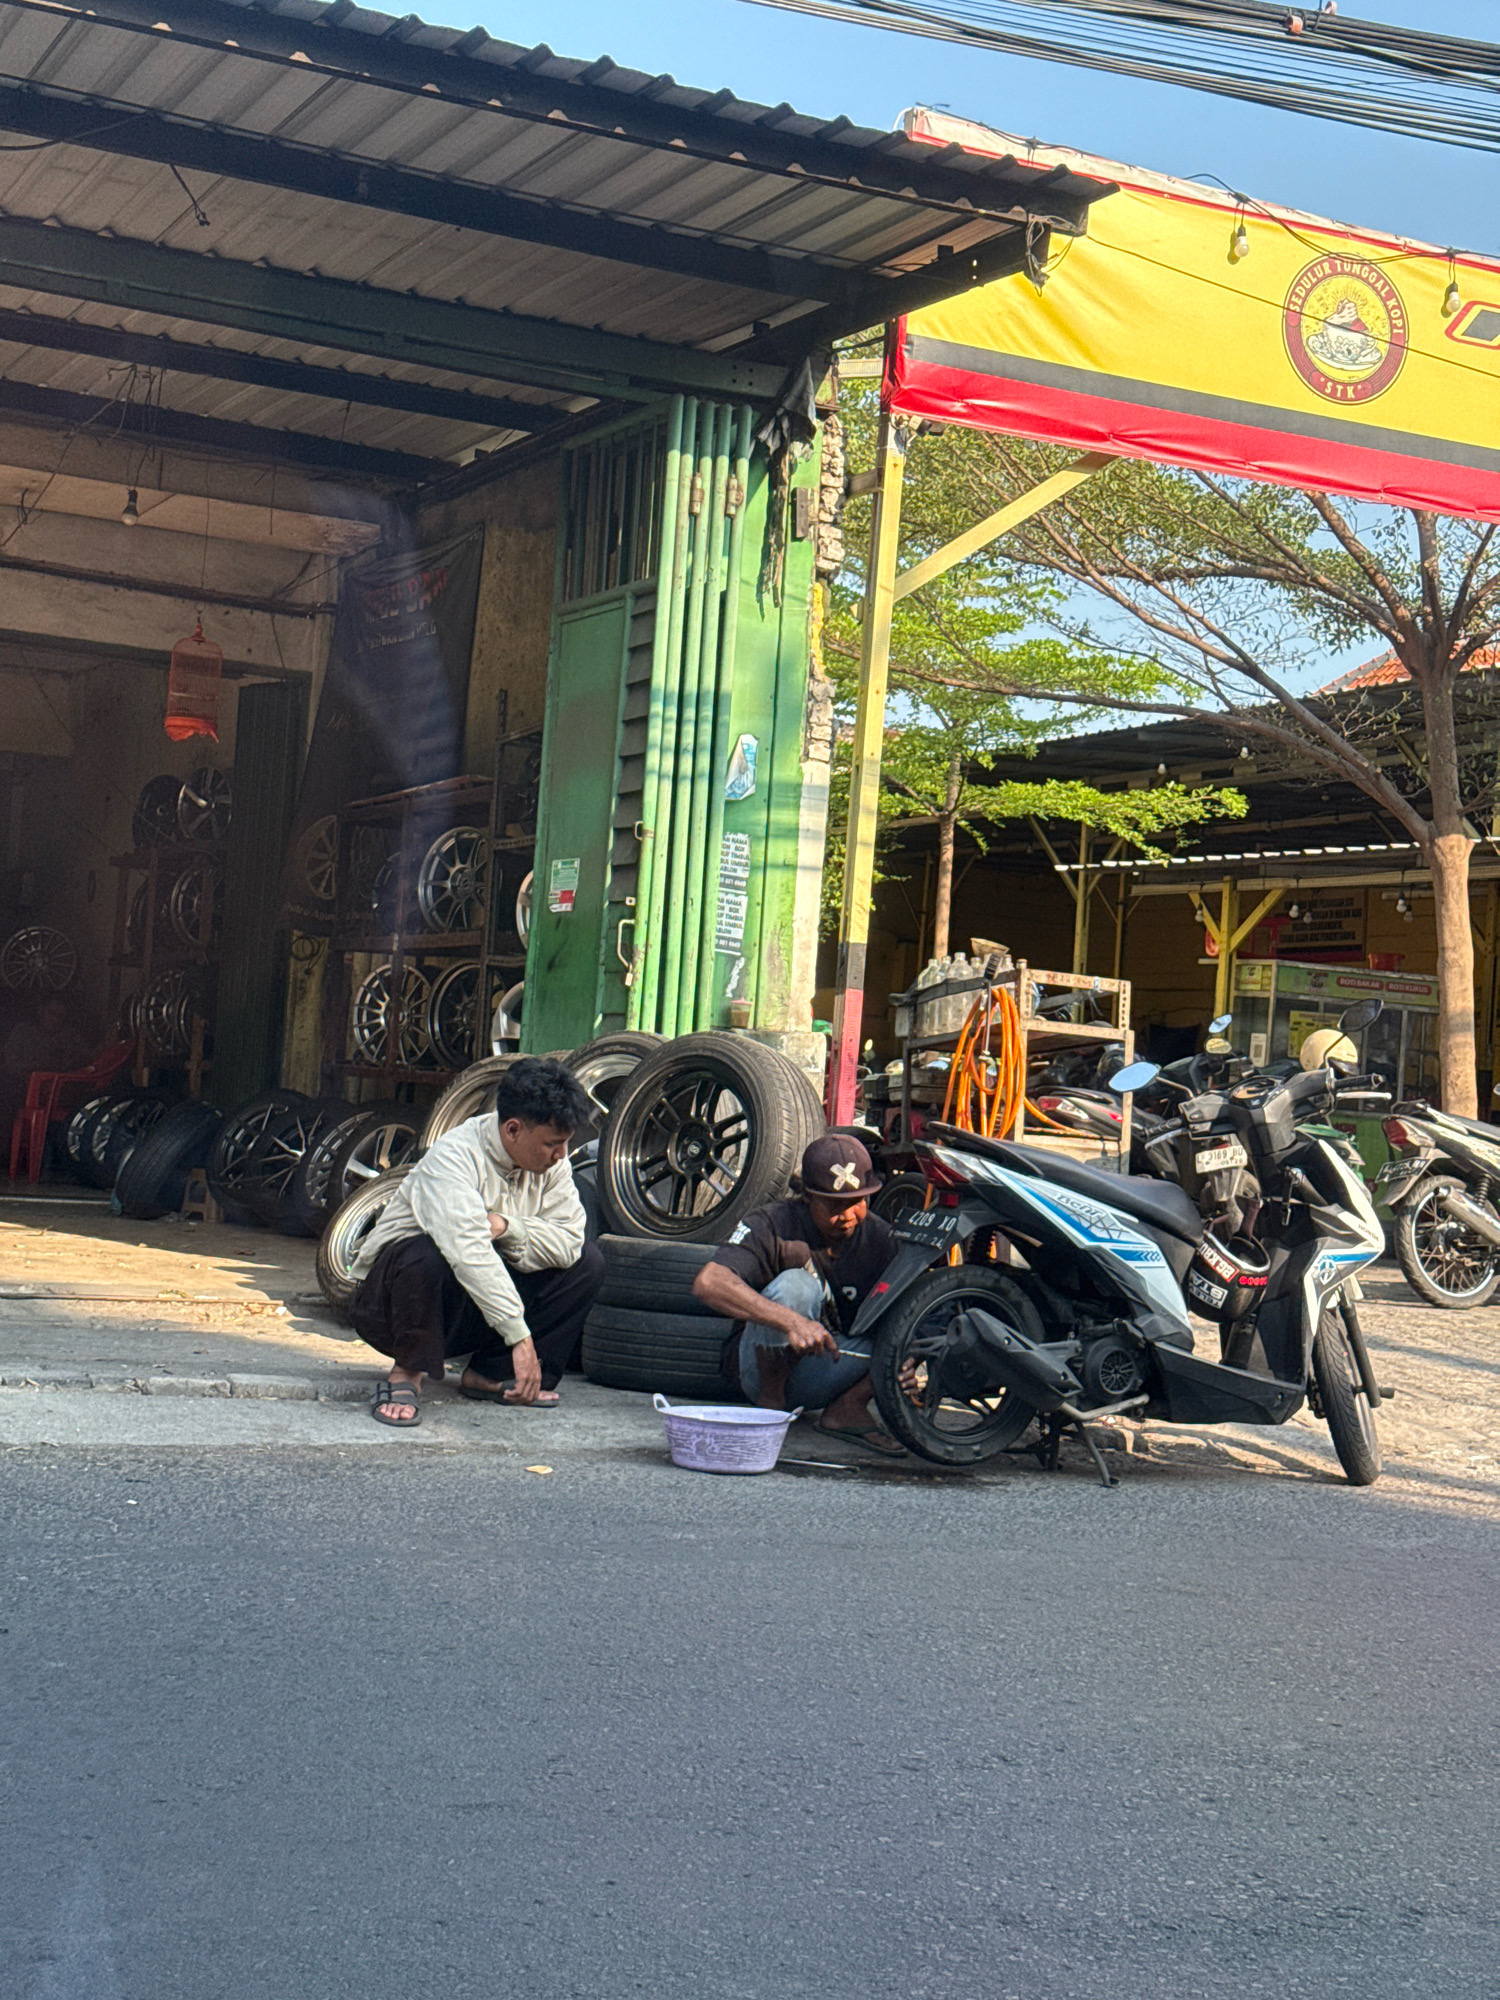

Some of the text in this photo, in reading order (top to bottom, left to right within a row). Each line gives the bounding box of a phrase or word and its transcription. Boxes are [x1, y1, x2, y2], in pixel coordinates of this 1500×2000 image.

[1289, 260, 1405, 335] SEDULUR TUNGGAL KOPI
[1340, 978, 1357, 987] ROTI
[1357, 979, 1380, 989] BAKAR
[1389, 982, 1429, 993] ROTI KUKUS
[908, 1210, 937, 1227] 4209
